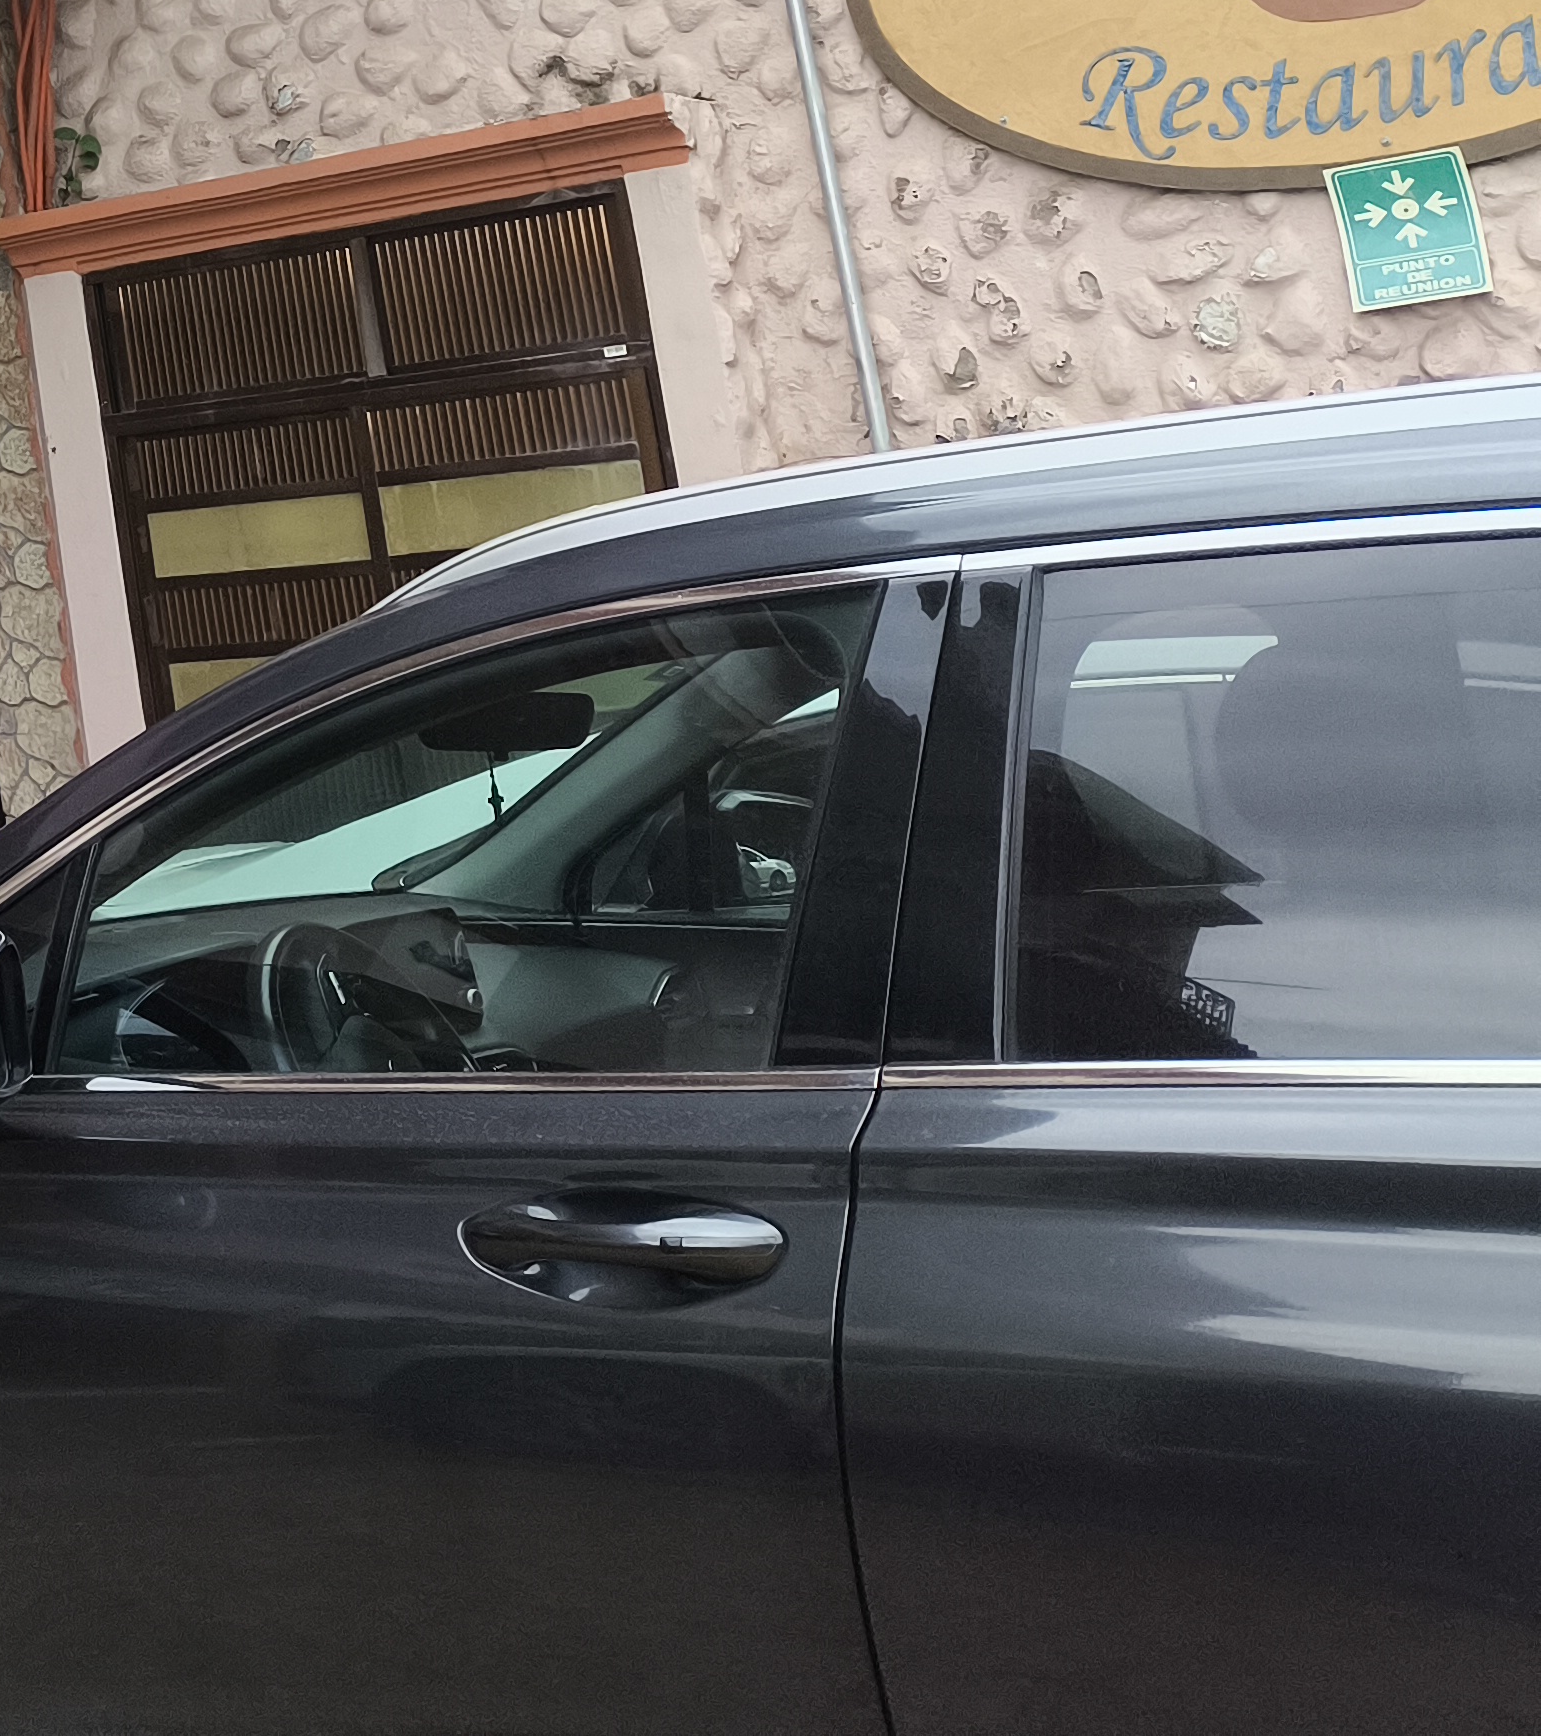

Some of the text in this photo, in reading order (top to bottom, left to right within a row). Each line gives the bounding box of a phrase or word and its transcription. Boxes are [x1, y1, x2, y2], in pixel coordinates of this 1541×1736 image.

[1079, 14, 1541, 161] Restaura
[1382, 255, 1455, 275] PUNTO
[1407, 269, 1434, 283] DE
[1375, 275, 1472, 299] REUNION
